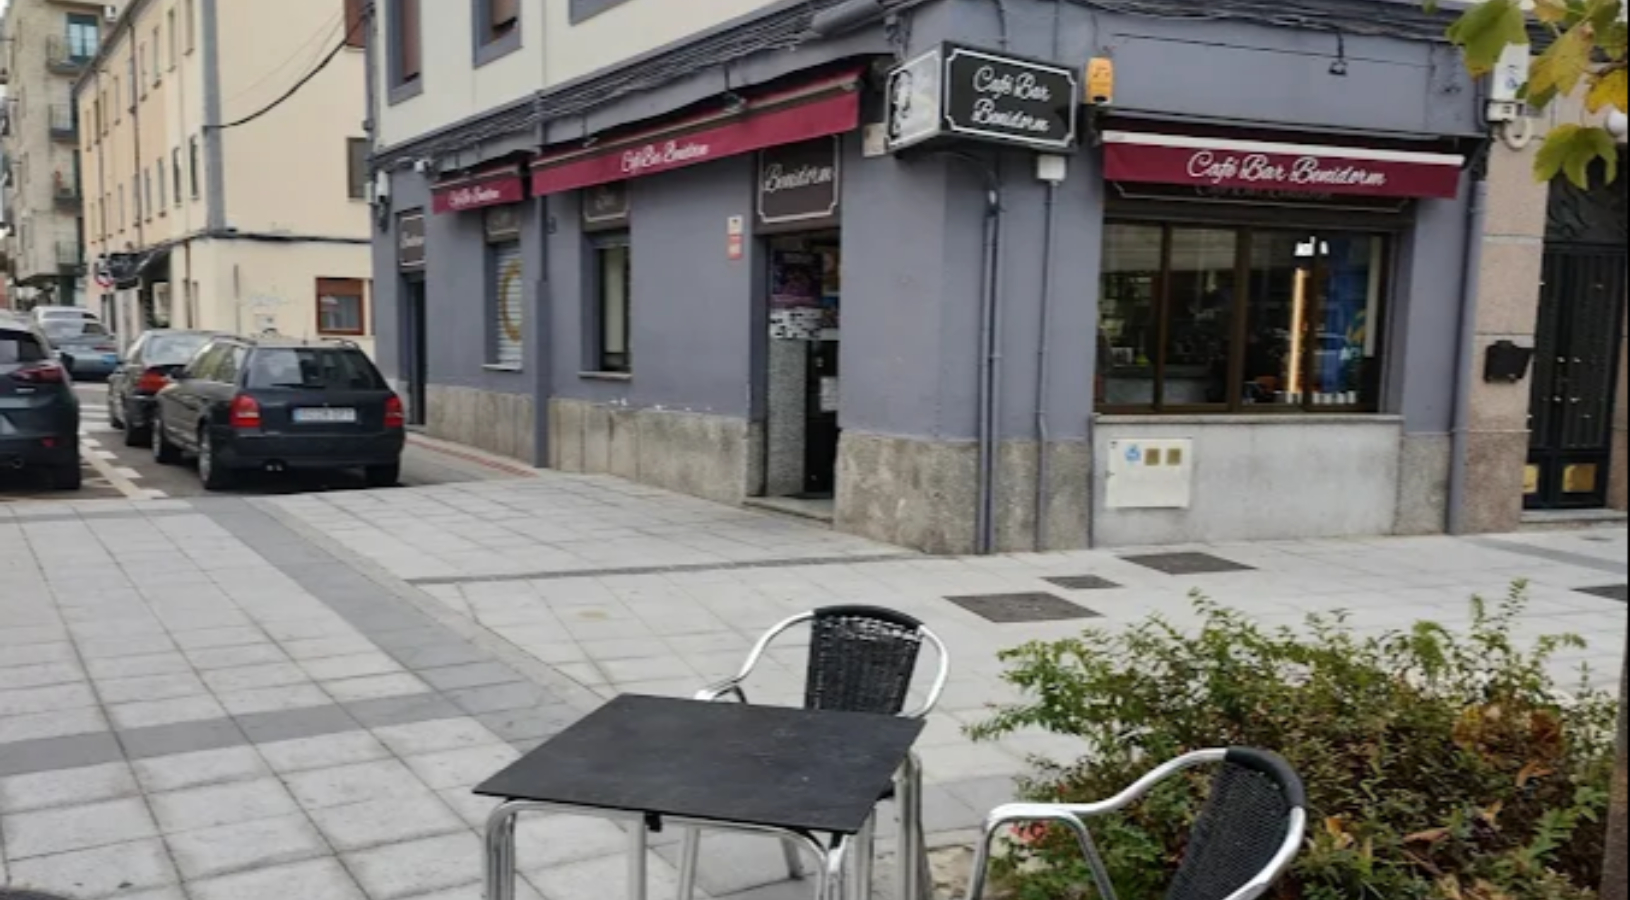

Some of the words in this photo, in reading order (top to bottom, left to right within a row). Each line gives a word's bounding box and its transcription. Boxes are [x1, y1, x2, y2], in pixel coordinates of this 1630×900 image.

[973, 65, 1013, 99] Café
[1013, 72, 1051, 102] Bar
[971, 98, 1050, 131] Benidorm
[764, 163, 832, 192] Benidorm
[1186, 150, 1234, 184] Café
[1239, 154, 1286, 182] Bar
[1290, 155, 1386, 187] Benidorm
